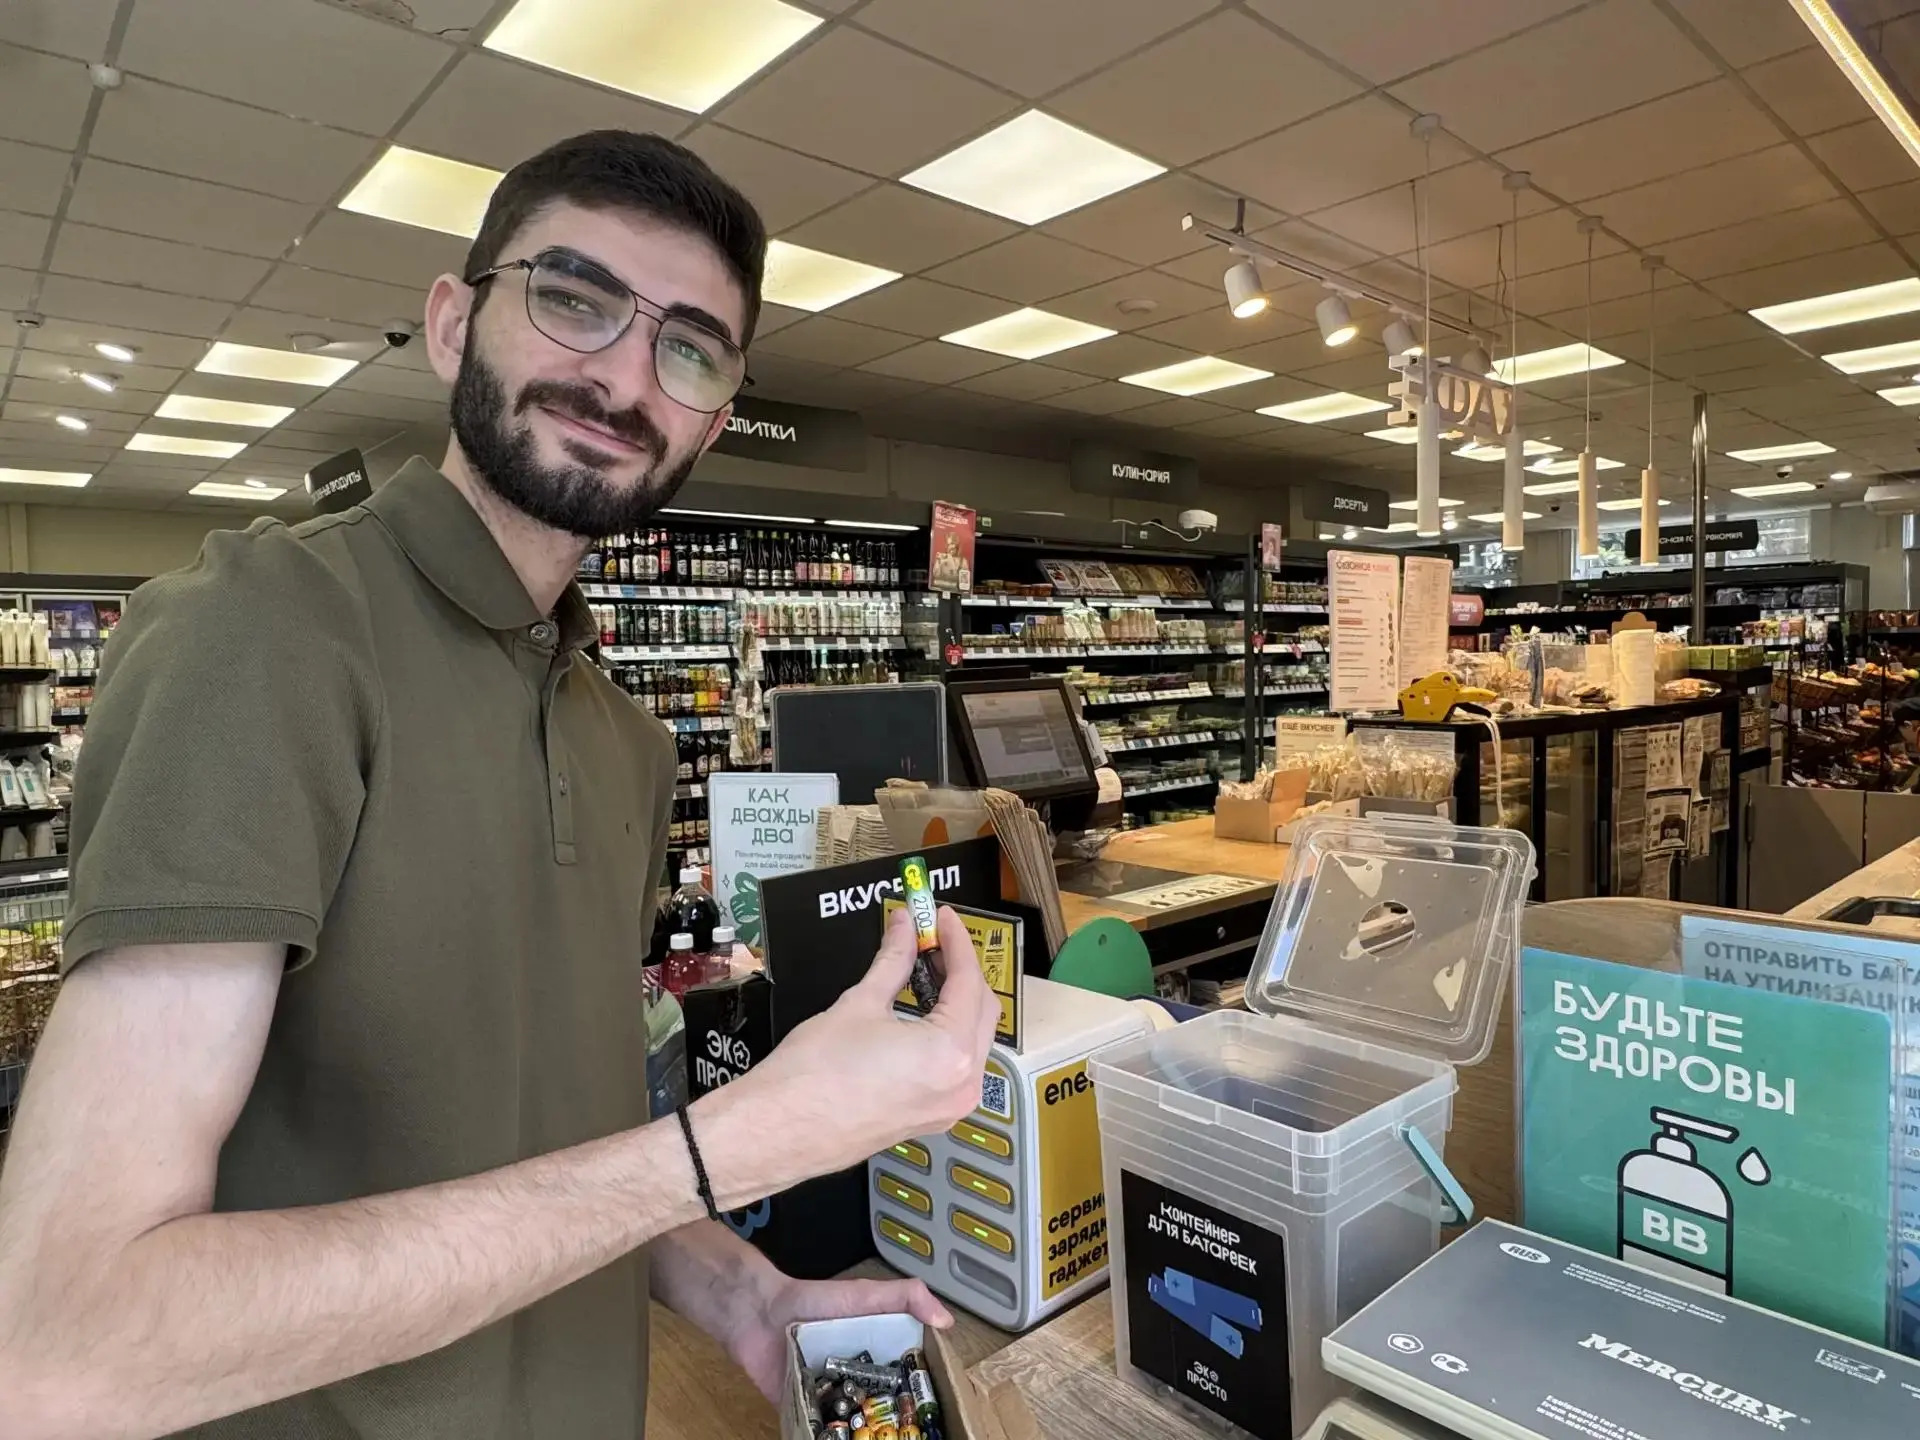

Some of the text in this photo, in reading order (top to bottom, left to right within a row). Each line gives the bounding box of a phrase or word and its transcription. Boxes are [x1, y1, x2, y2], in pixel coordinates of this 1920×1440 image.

[1112, 463, 1170, 484] КУЛИНАРИЯ
[748, 787, 789, 804] КАК
[731, 807, 815, 827] ДВАЖДЫ
[752, 827, 794, 846] ДВА
[913, 896, 933, 929] 2700
[1704, 941, 1853, 978] ОТПРАВИТЬ
[1704, 966, 1737, 986] НА
[1554, 980, 1743, 1053] БУДЬТЕ
[1554, 1026, 1795, 1115] ЗДОРОВЫ
[1160, 1202, 1241, 1246] КОНТЕЙНЕР
[1148, 1213, 1257, 1276] ДЛЯ БАТАРЕЕК
[1507, 1245, 1542, 1261] RUS
[1186, 1369, 1227, 1401] ПРОСТО
[1577, 1333, 1797, 1424] MERCURY
[1541, 1400, 1625, 1440] from worldwide
[1546, 1395, 1600, 1421] Equipment
[1600, 1418, 1618, 1429] for
[1679, 1386, 1787, 1432] equipment
